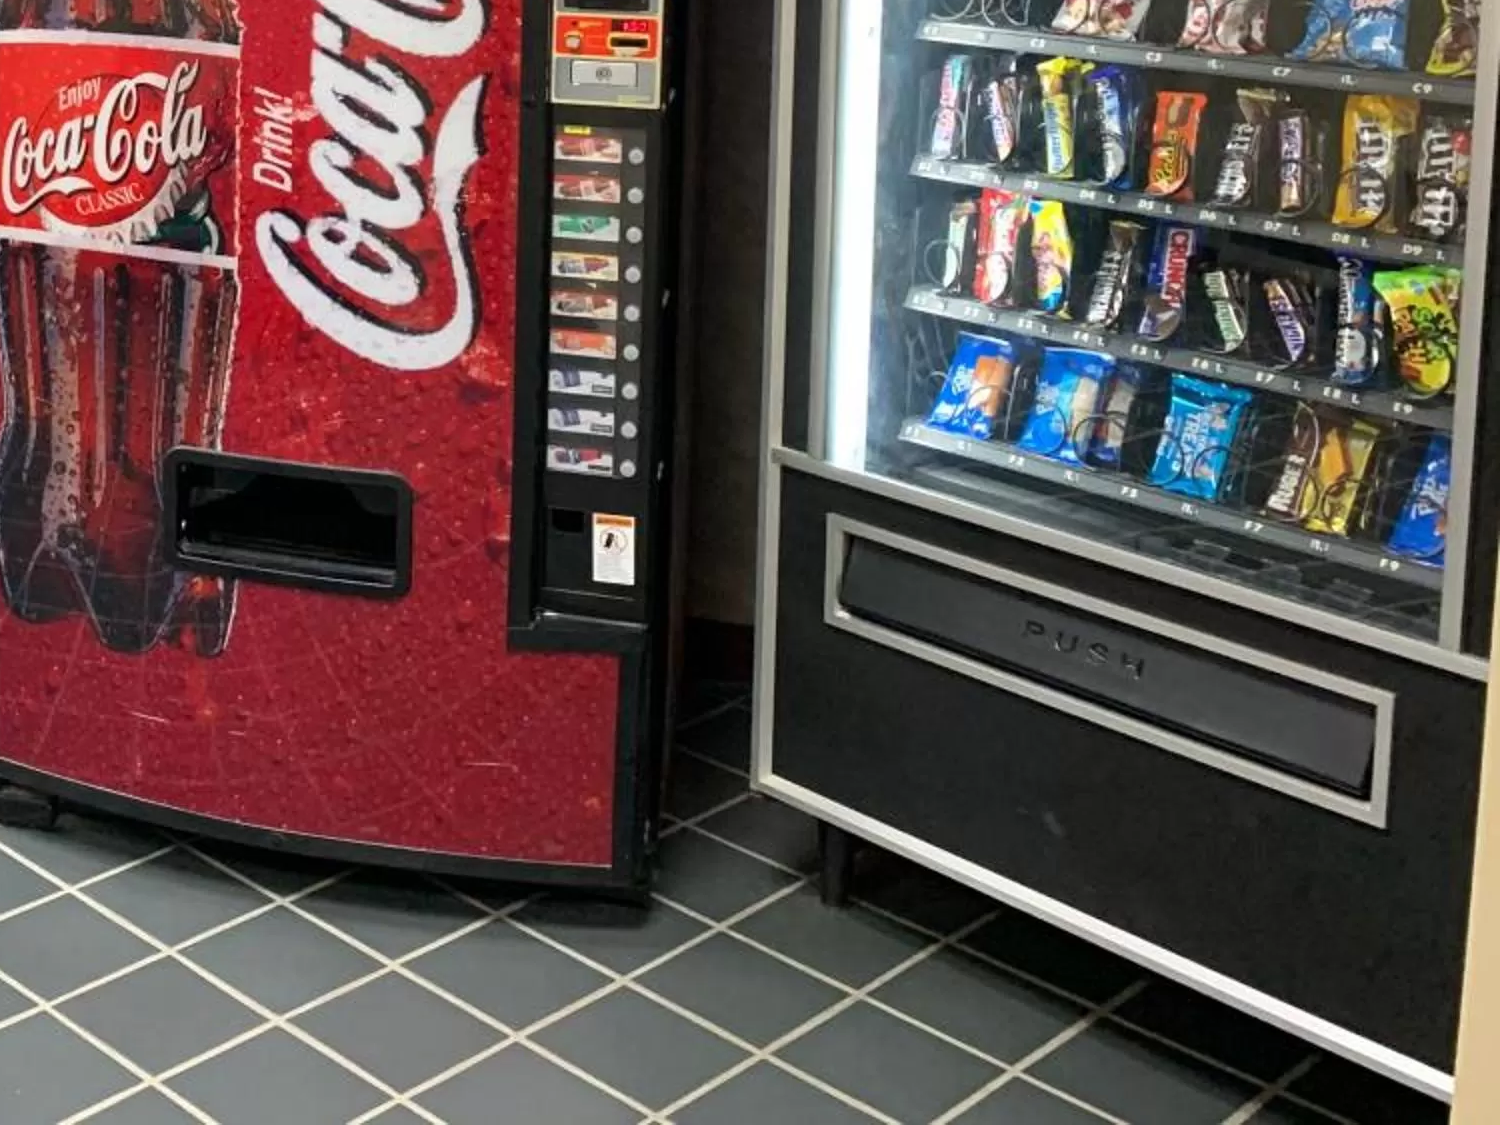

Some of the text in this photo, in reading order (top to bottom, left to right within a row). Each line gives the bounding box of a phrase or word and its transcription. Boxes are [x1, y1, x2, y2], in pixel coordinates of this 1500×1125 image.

[1271, 66, 1292, 76] C7
[58, 76, 101, 111] Enjoy
[1411, 83, 1433, 94] C9
[1, 58, 207, 214] Coca-Cola
[252, 85, 295, 194] Drink!
[75, 182, 145, 216] CLASSIC
[1263, 220, 1283, 233] D7
[1402, 244, 1423, 257] D9
[1255, 372, 1276, 384] E7
[1392, 401, 1414, 414] E9
[1243, 520, 1264, 533] F7
[1379, 557, 1401, 572] F9
[1021, 619, 1146, 680] PUSH
